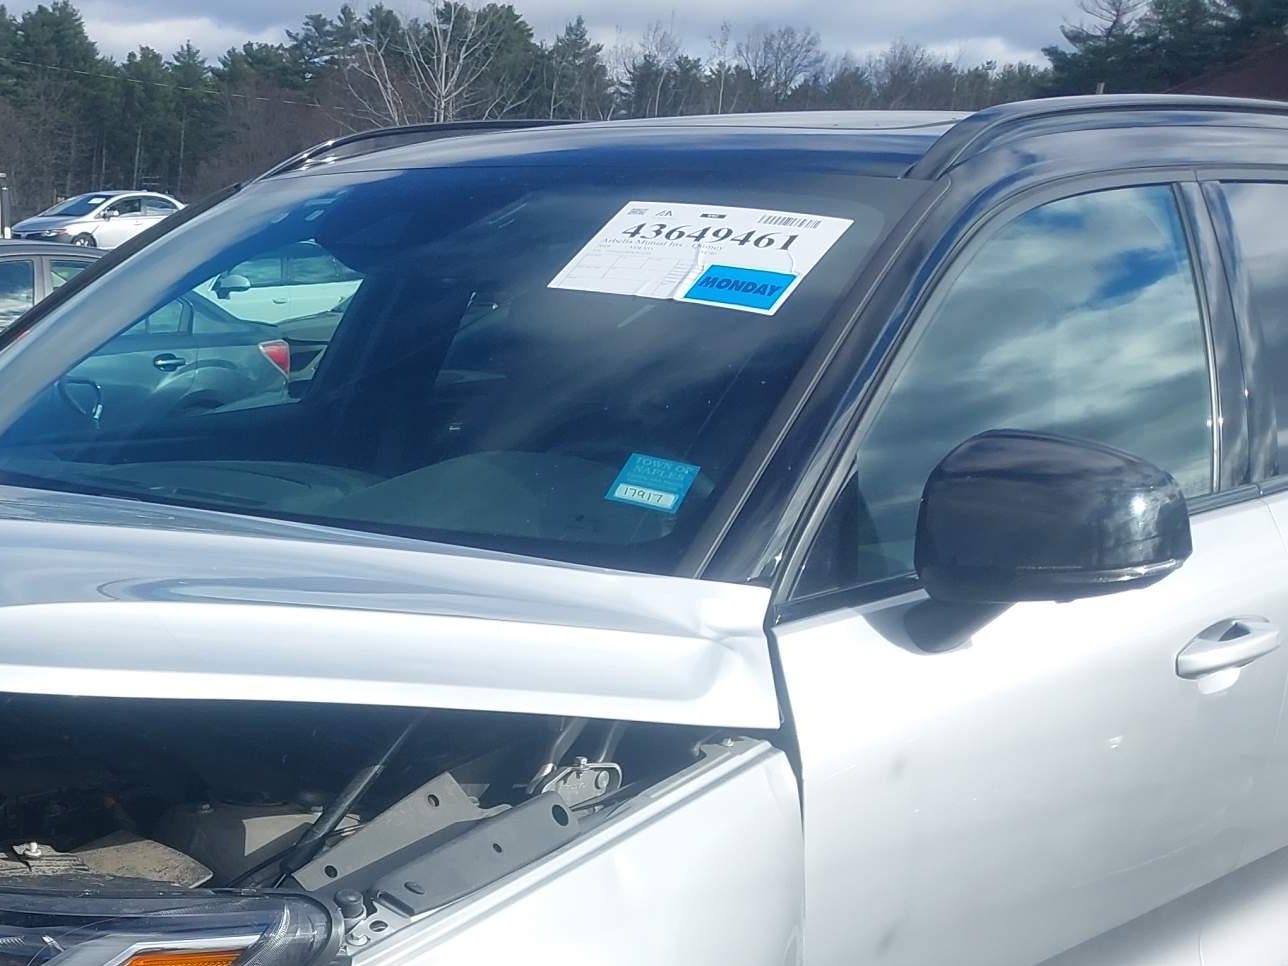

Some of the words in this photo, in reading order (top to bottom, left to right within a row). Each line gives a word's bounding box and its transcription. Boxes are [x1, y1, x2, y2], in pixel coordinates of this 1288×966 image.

[621, 222, 800, 251] 43649461
[699, 274, 783, 298] MONDAY
[624, 486, 664, 503] 17917
